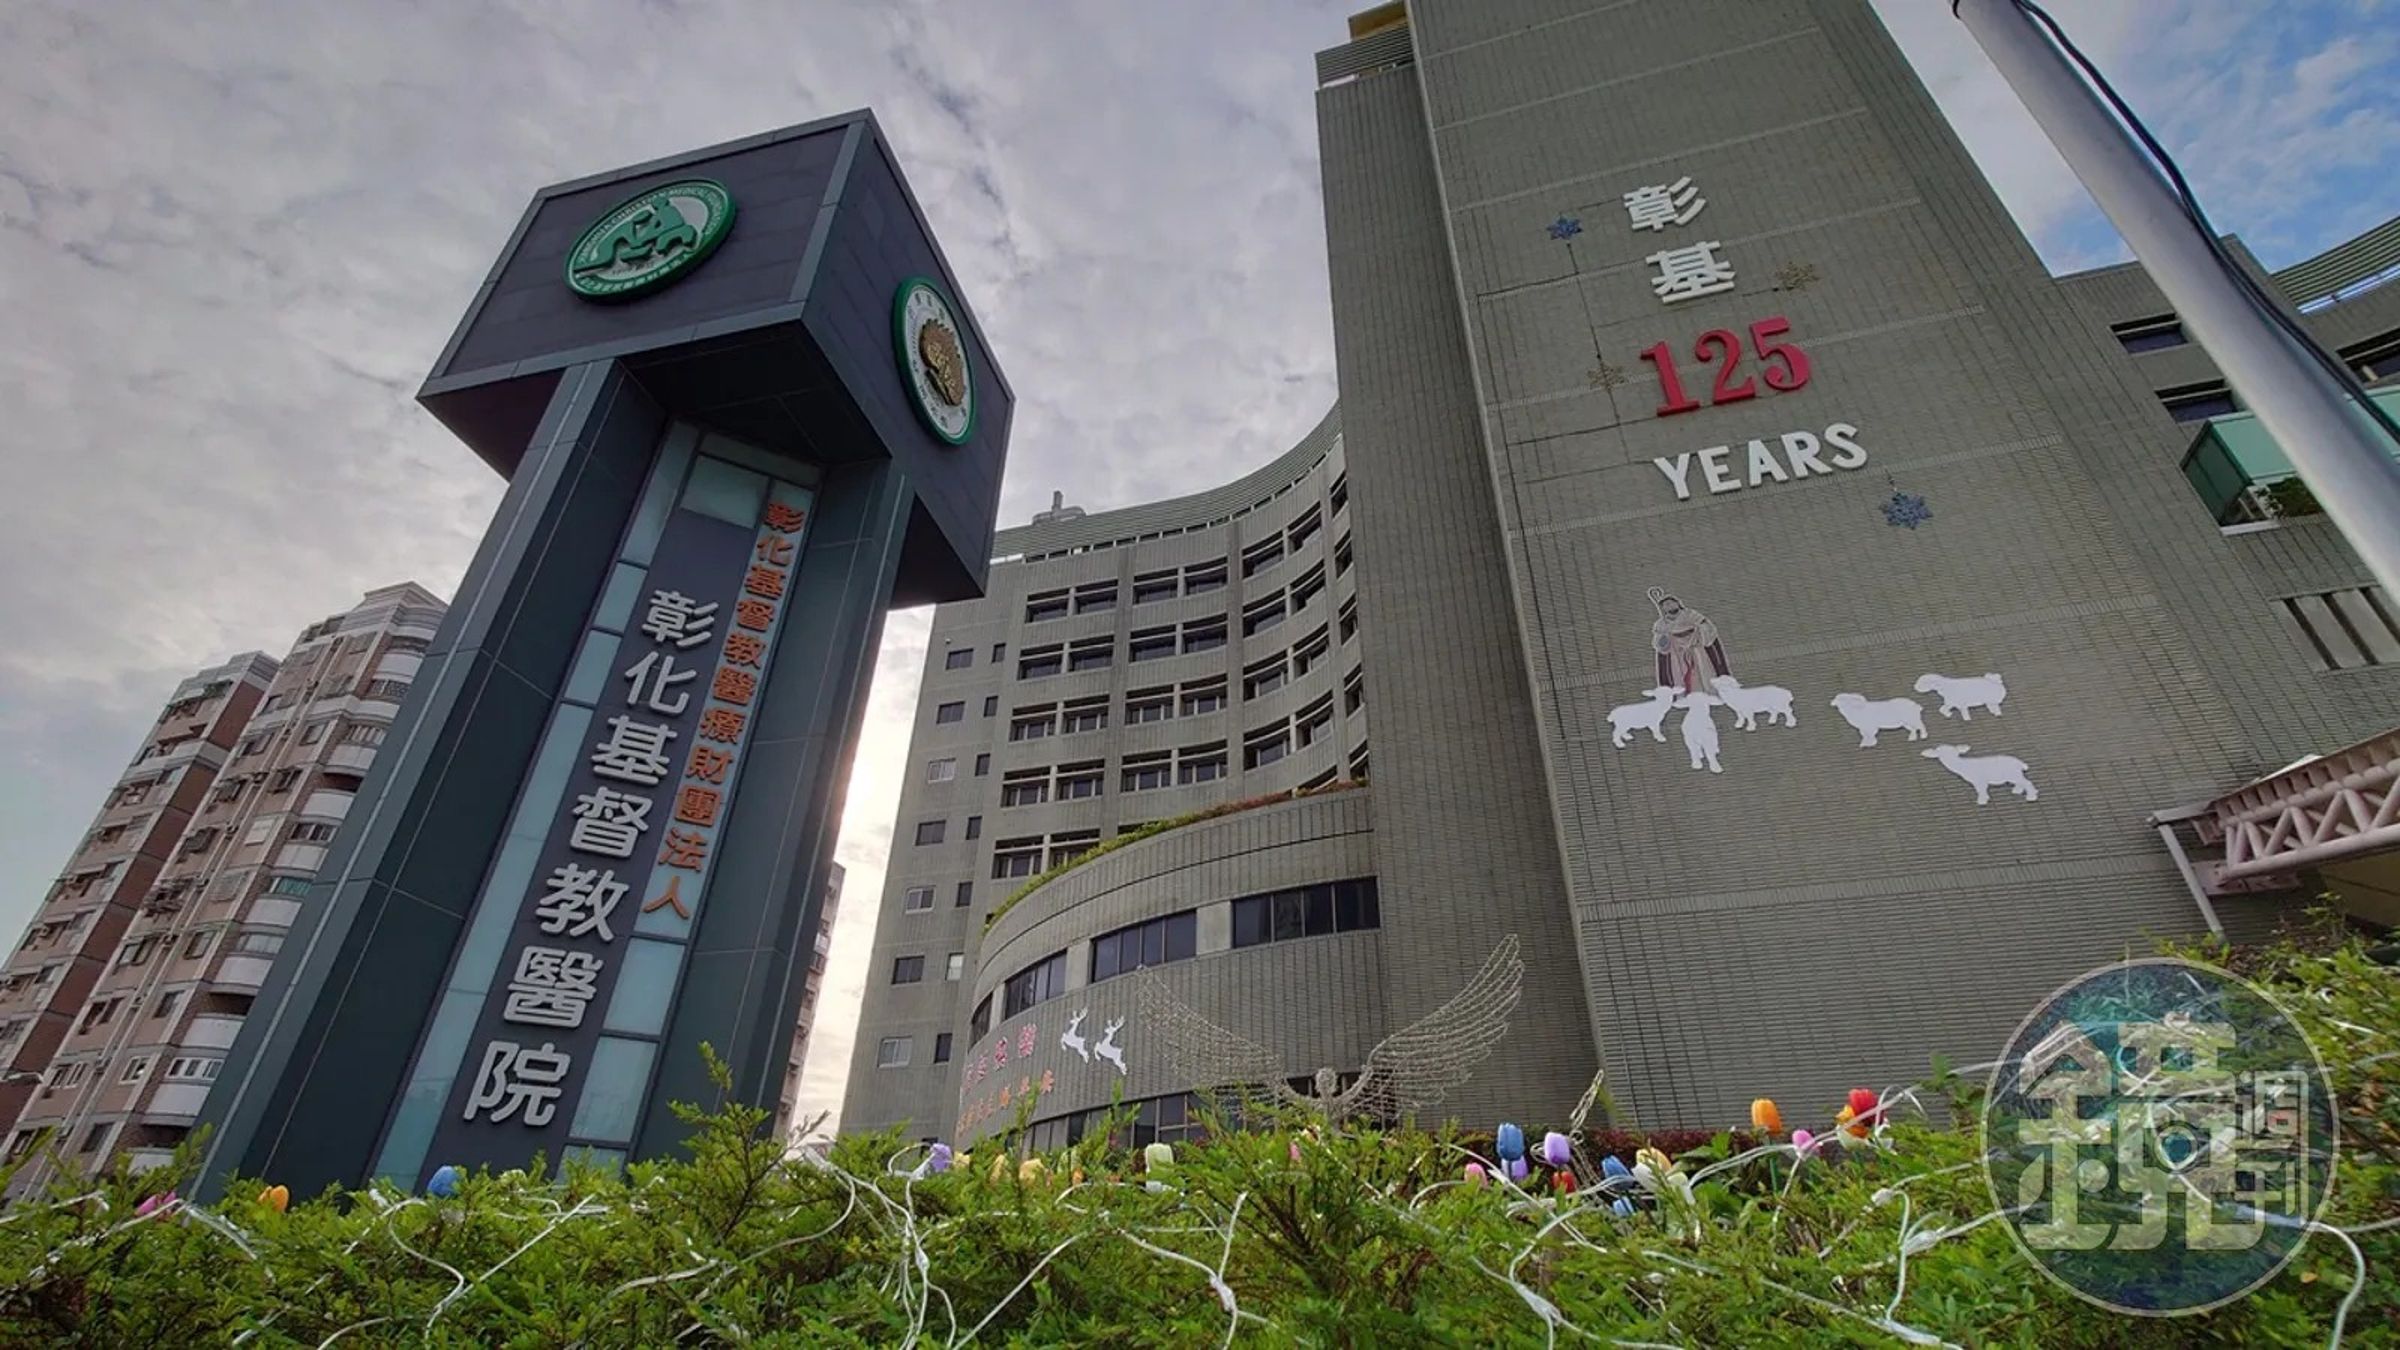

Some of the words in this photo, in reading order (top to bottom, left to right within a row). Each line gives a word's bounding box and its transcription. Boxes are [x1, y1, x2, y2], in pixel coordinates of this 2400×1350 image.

[1623, 176, 1736, 303] 彰基
[1640, 316, 1811, 418] 125
[1654, 422, 1868, 500] YEARS
[643, 502, 806, 920] 彰化基督教醫療財團法人
[462, 588, 719, 1128] 彰化基督教醫院
